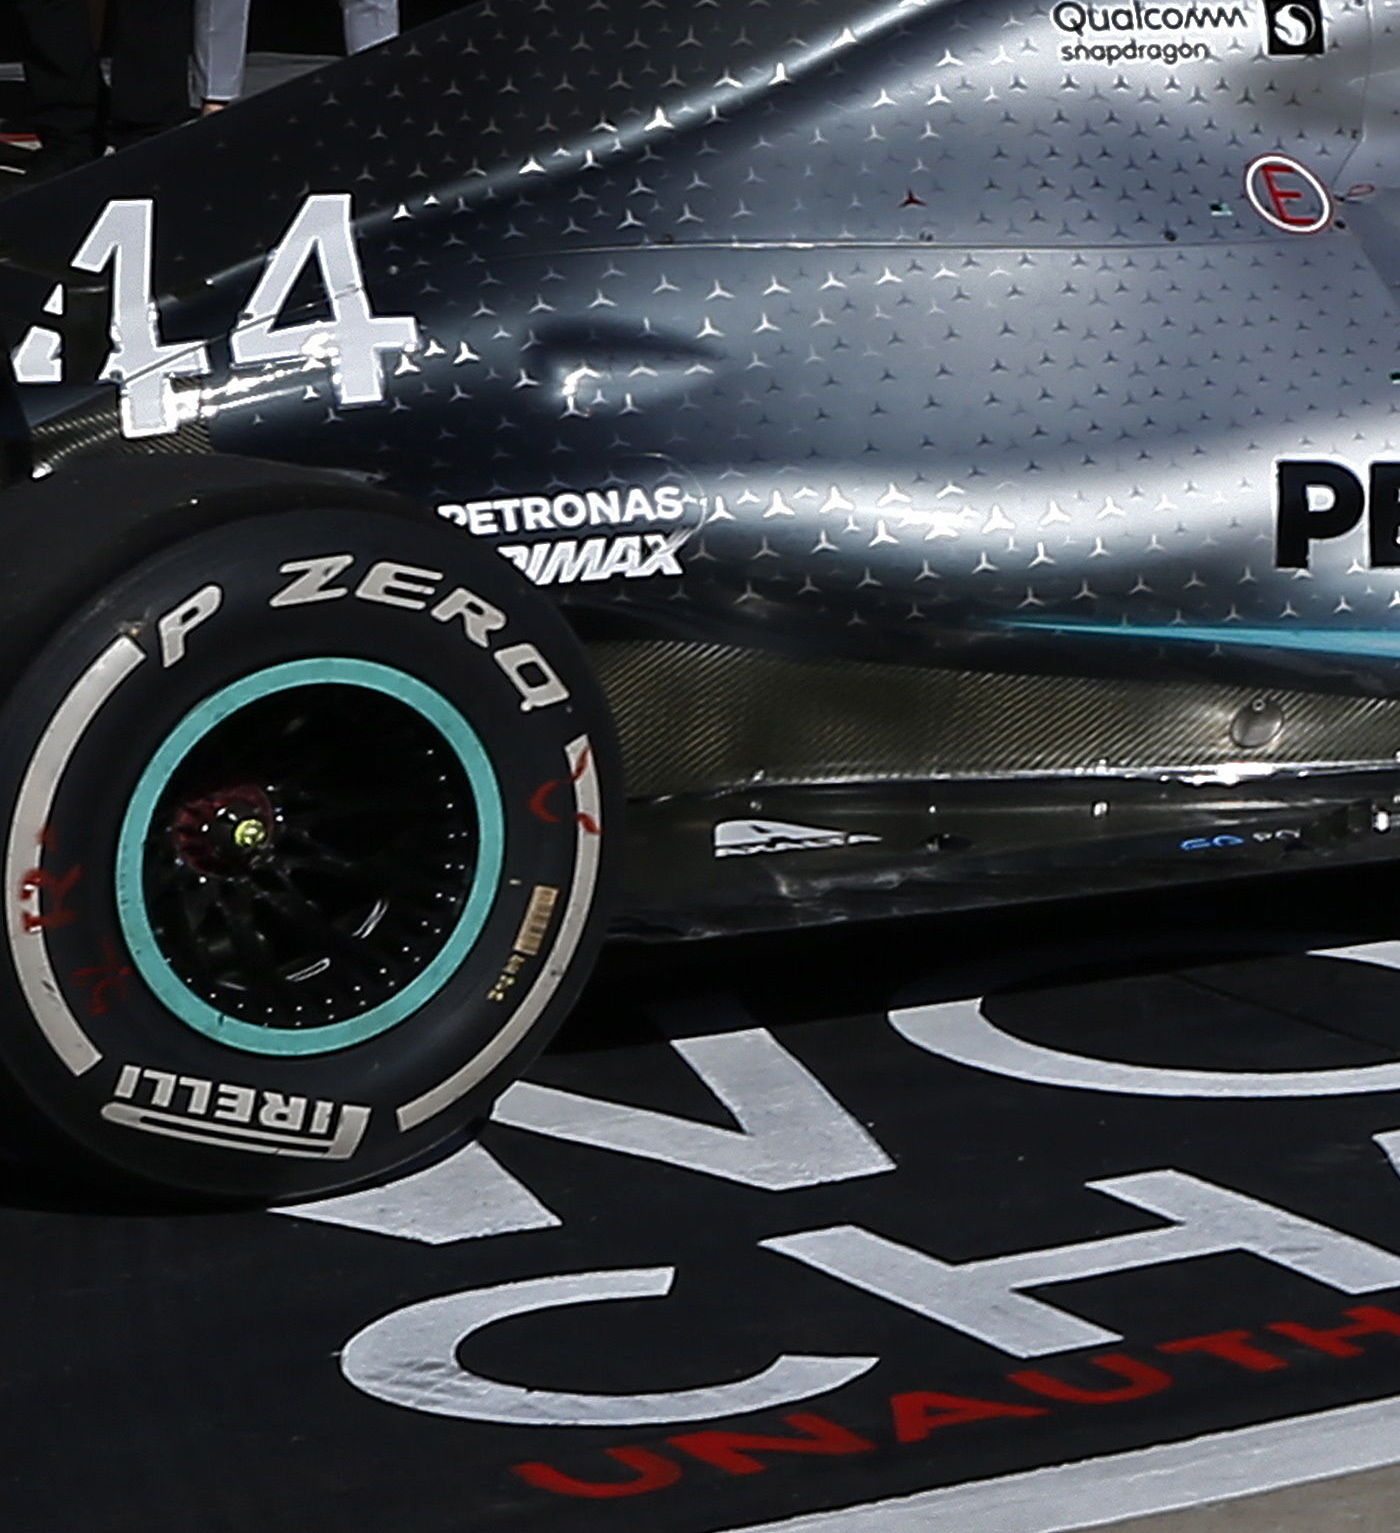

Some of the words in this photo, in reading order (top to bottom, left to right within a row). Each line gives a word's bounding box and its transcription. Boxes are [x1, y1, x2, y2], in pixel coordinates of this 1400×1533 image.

[1052, 0, 1247, 36] Qualcomm
[1060, 38, 1211, 66] snapdragon
[156, 582, 224, 669] P
[267, 553, 572, 713] ZERO
[100, 1063, 373, 1160] PIRELLI
